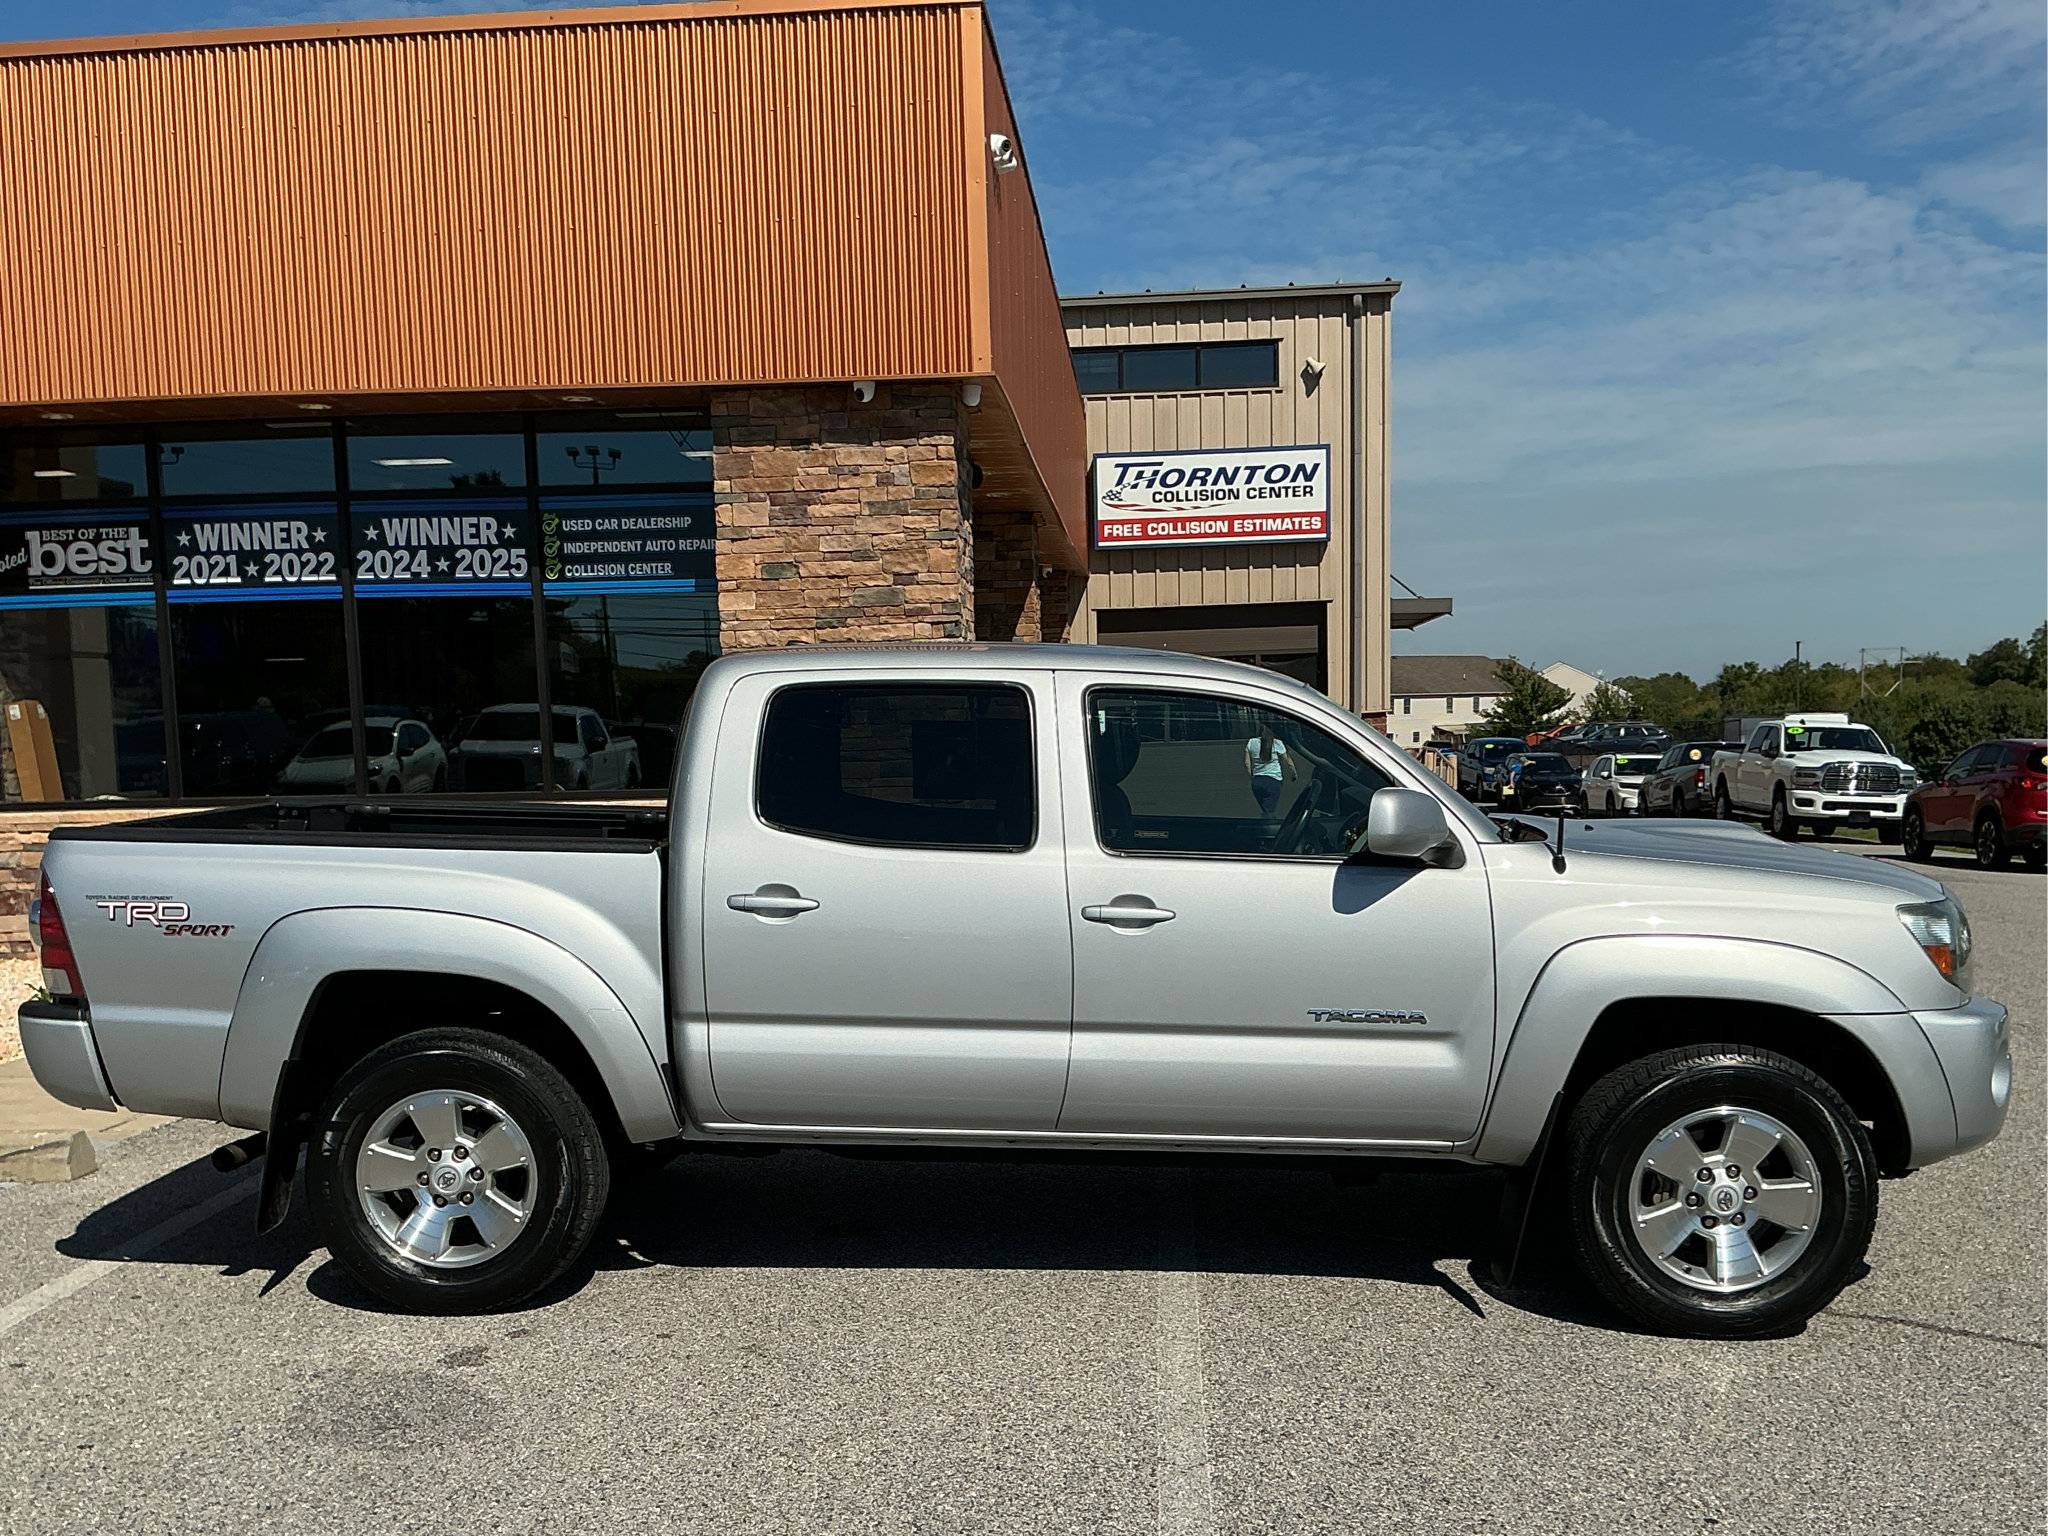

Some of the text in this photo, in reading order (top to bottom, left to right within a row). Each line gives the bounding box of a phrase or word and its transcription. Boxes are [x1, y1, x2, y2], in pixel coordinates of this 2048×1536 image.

[1114, 461, 1321, 490] THORNTON
[1152, 485, 1314, 503] COLLISION CENTER
[381, 516, 499, 546] WINNER
[562, 516, 692, 531] USED CAR DEALERSHIP
[1103, 516, 1322, 537] FREE COLLISION ESTIMATES
[42, 528, 127, 541] BEST OF THE
[193, 521, 310, 552] WINNER
[25, 527, 153, 576] best
[563, 540, 642, 554] INDEPENDENT
[645, 539, 676, 552] AUTO
[172, 552, 337, 585] 2021 2022
[356, 548, 528, 579] 2024 2025
[564, 562, 672, 577] COLLISION CENTER
[96, 901, 191, 927] TRD
[163, 924, 231, 937] SPORT
[1306, 1008, 1428, 1024] TACOMA
